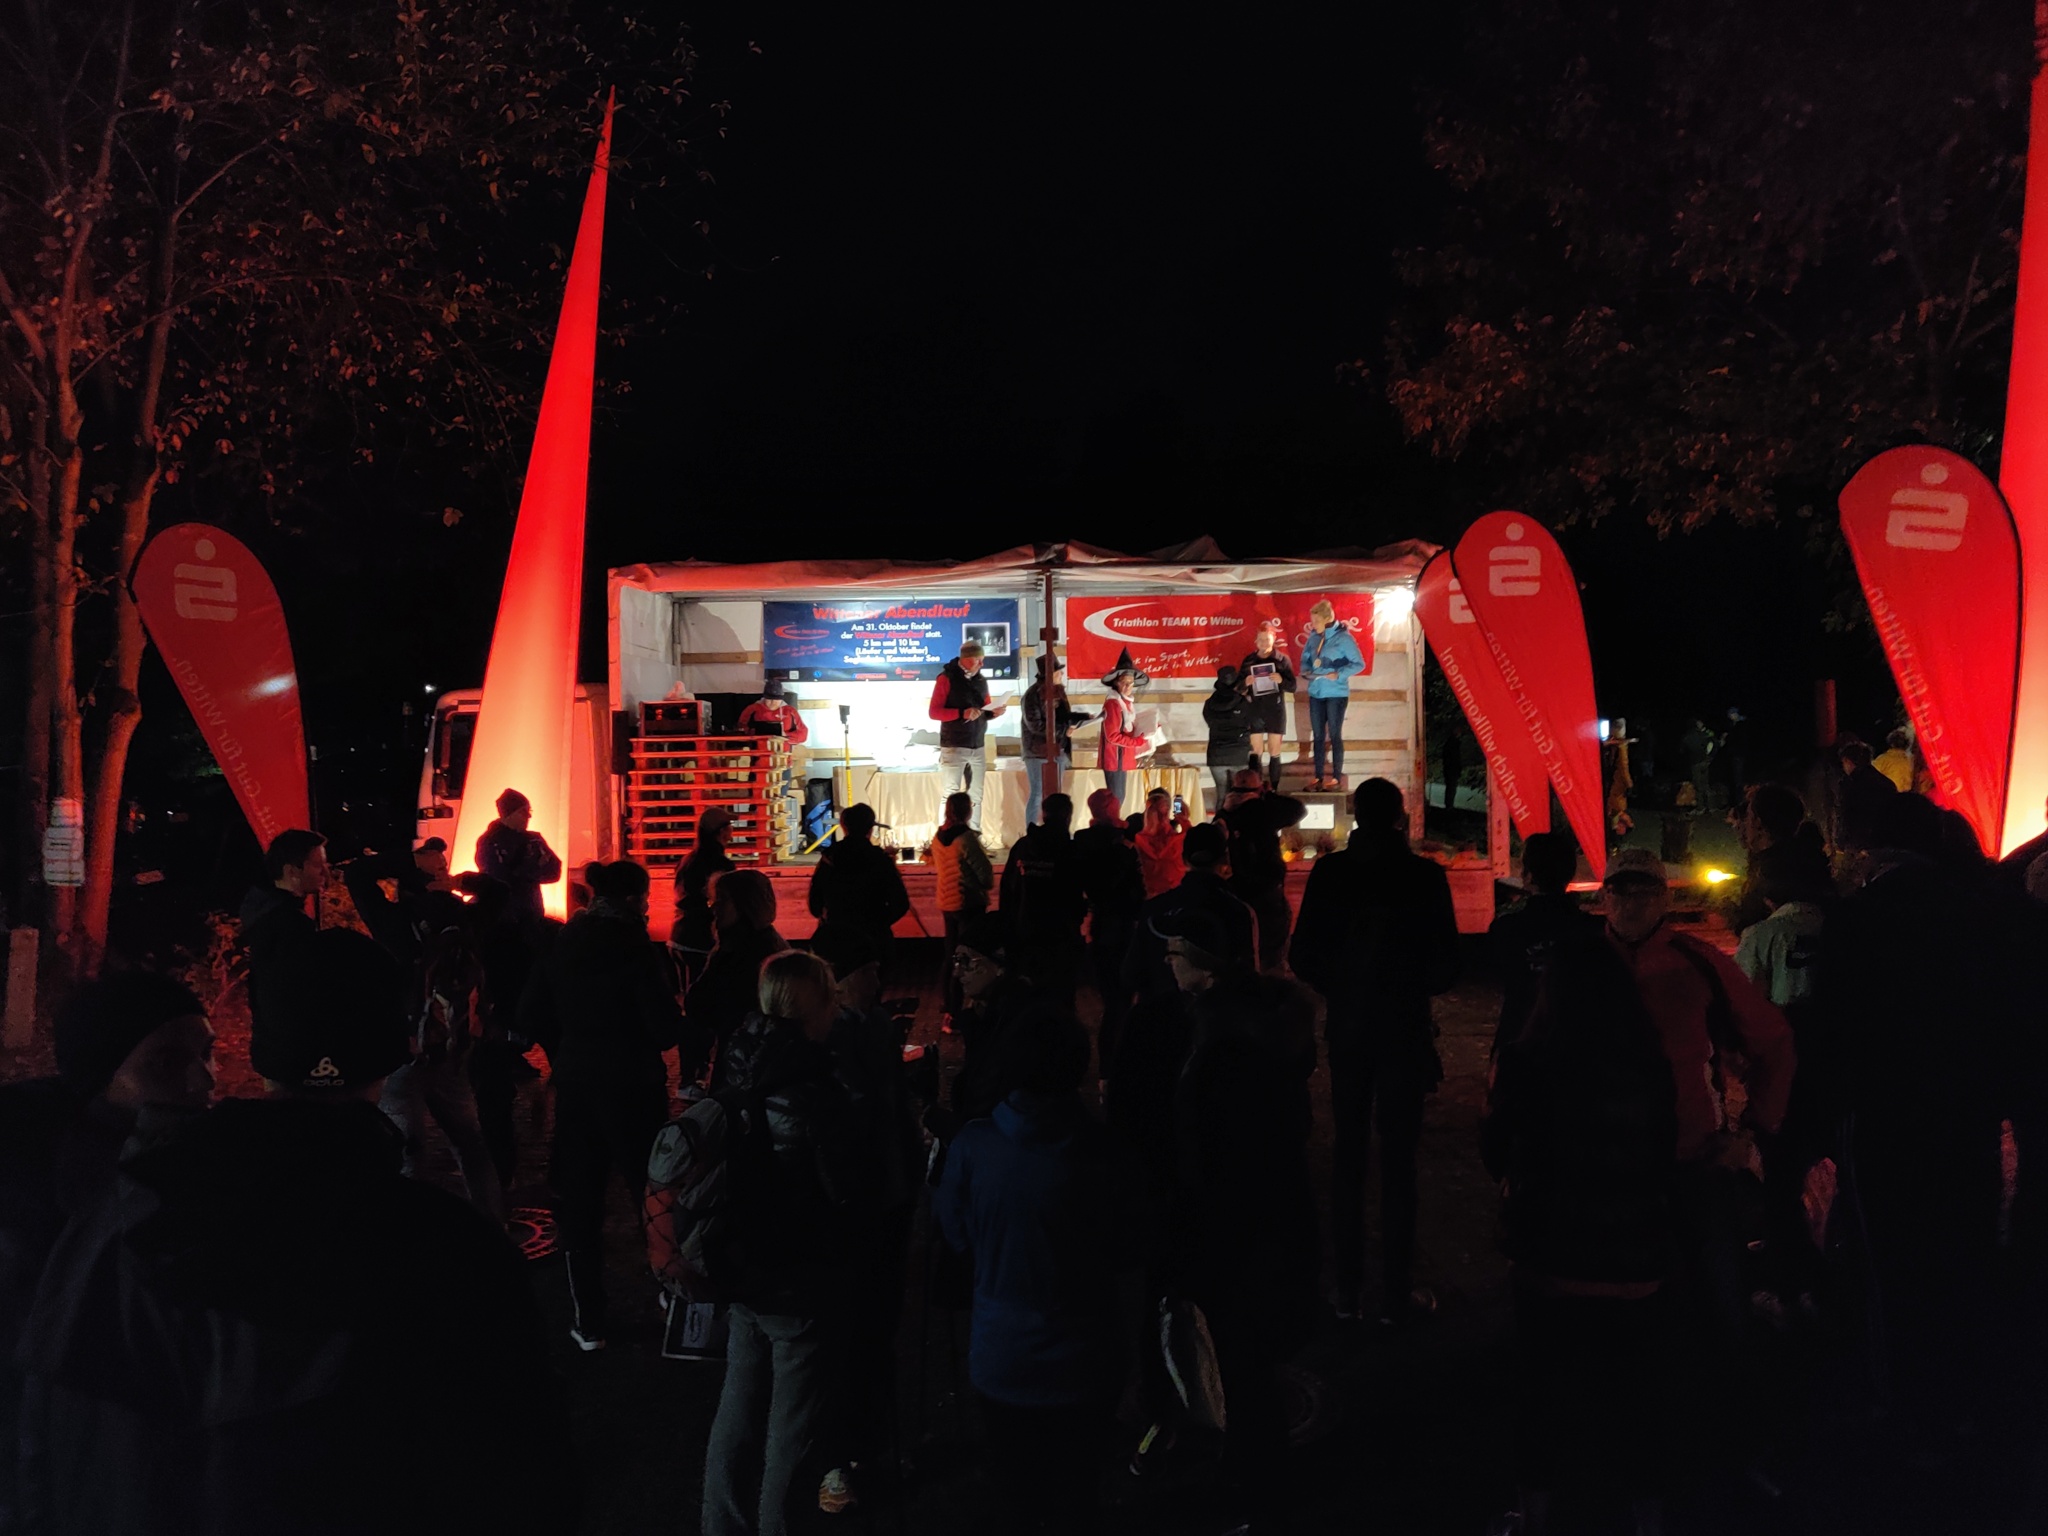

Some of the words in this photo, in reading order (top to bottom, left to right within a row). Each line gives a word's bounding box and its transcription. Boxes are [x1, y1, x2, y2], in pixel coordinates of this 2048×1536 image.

[885, 604, 971, 619] Abendlauf
[851, 623, 864, 631] Am
[866, 623, 877, 631] 31.
[878, 622, 909, 631] Oktober
[911, 621, 932, 630] findet
[1113, 617, 1159, 627] Triathlon
[1162, 616, 1190, 626] TEAM
[1193, 616, 1208, 626] TG
[1210, 616, 1244, 626] Witten
[841, 631, 853, 639] der
[925, 630, 942, 638] statt.
[882, 638, 896, 646] und
[898, 638, 908, 646] 10
[883, 646, 897, 654] und
